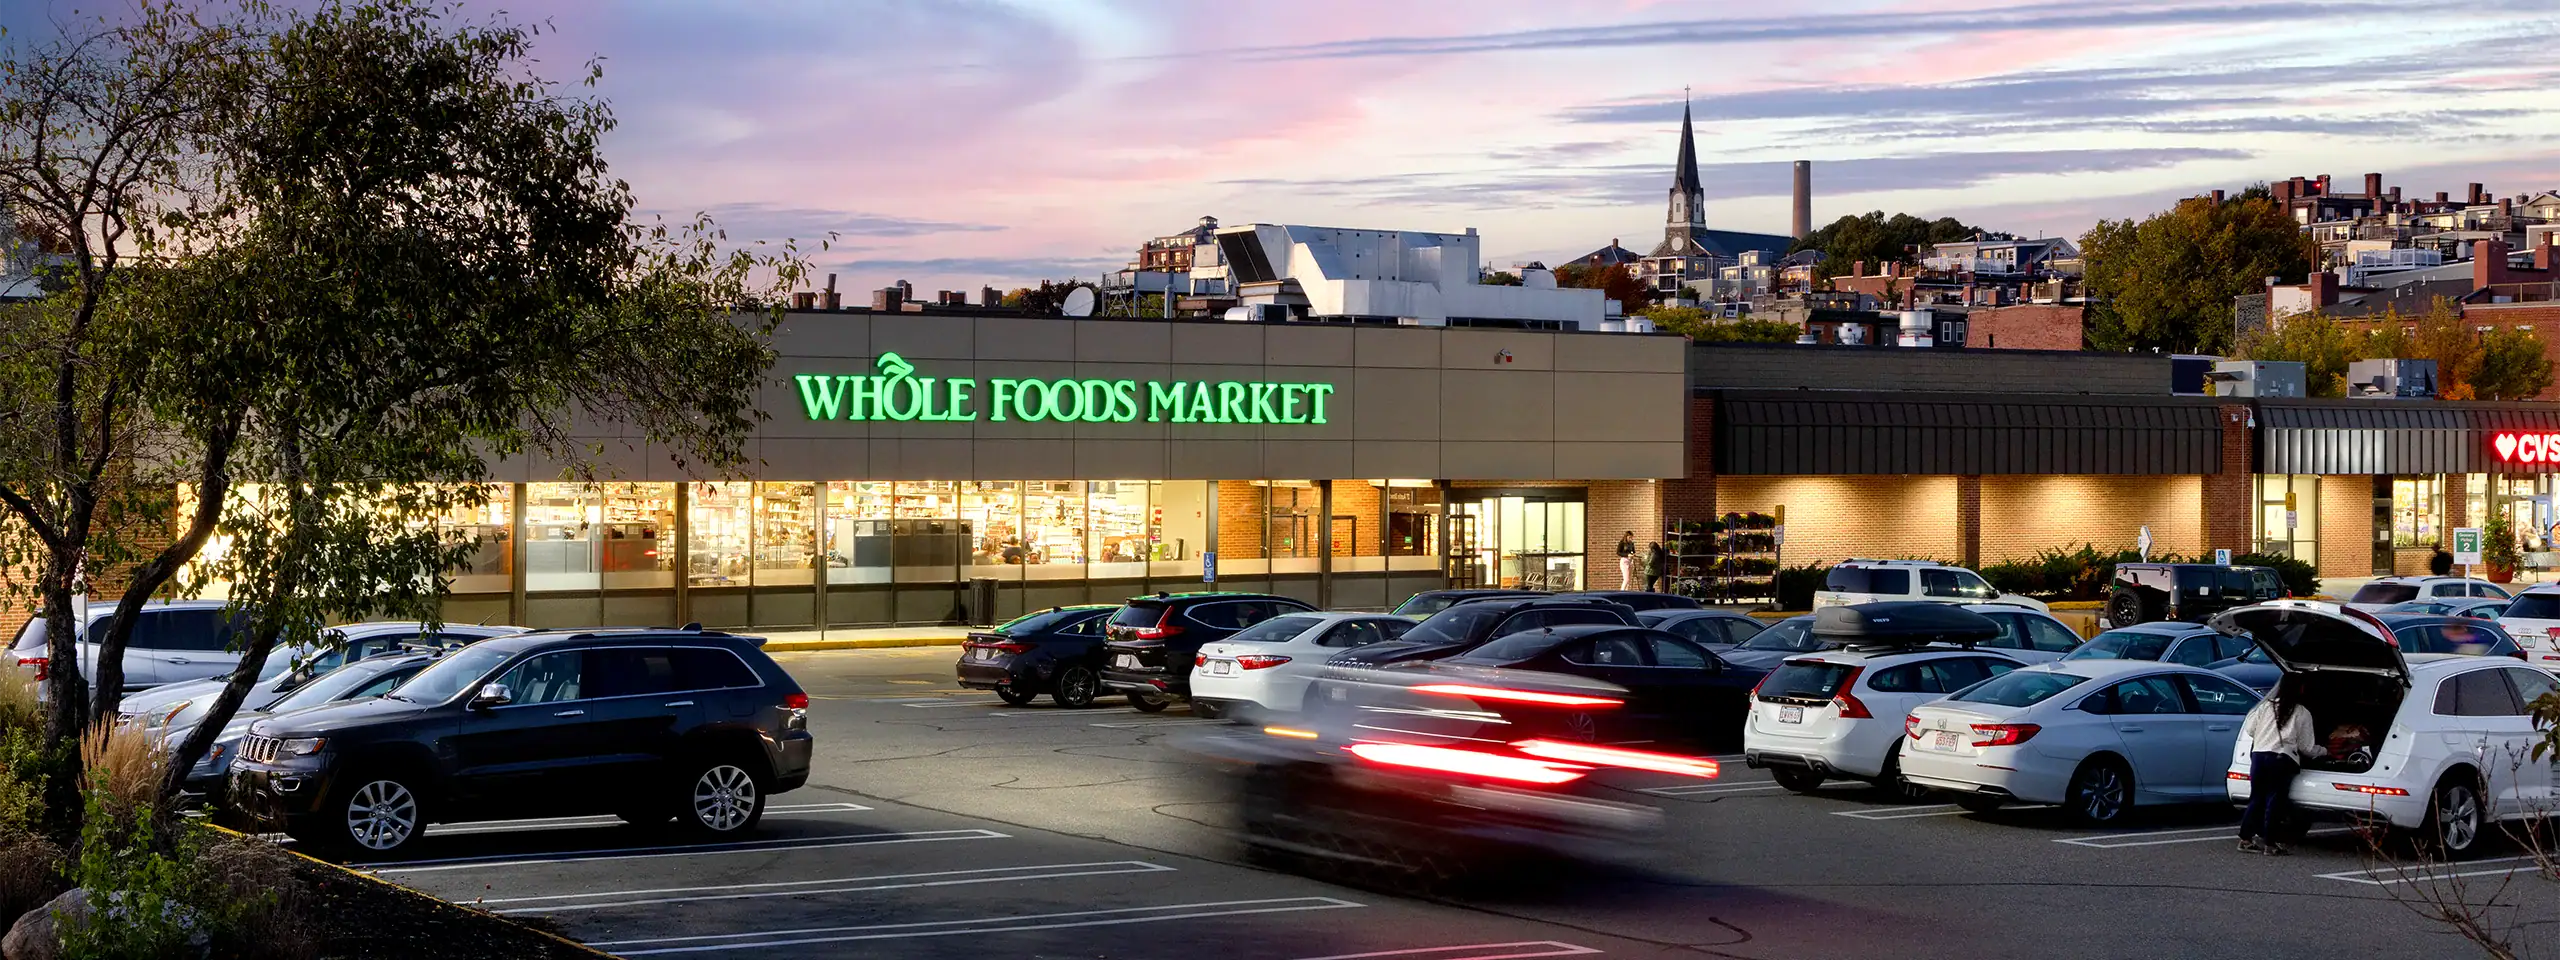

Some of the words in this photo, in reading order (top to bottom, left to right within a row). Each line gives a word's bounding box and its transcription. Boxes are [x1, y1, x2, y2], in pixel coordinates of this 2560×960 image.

[795, 358, 977, 422] WHOLE
[990, 378, 1138, 423] FOODS
[1147, 380, 1335, 425] MARKET
[2517, 433, 2560, 463] CVS
[2463, 542, 2471, 552] 2
